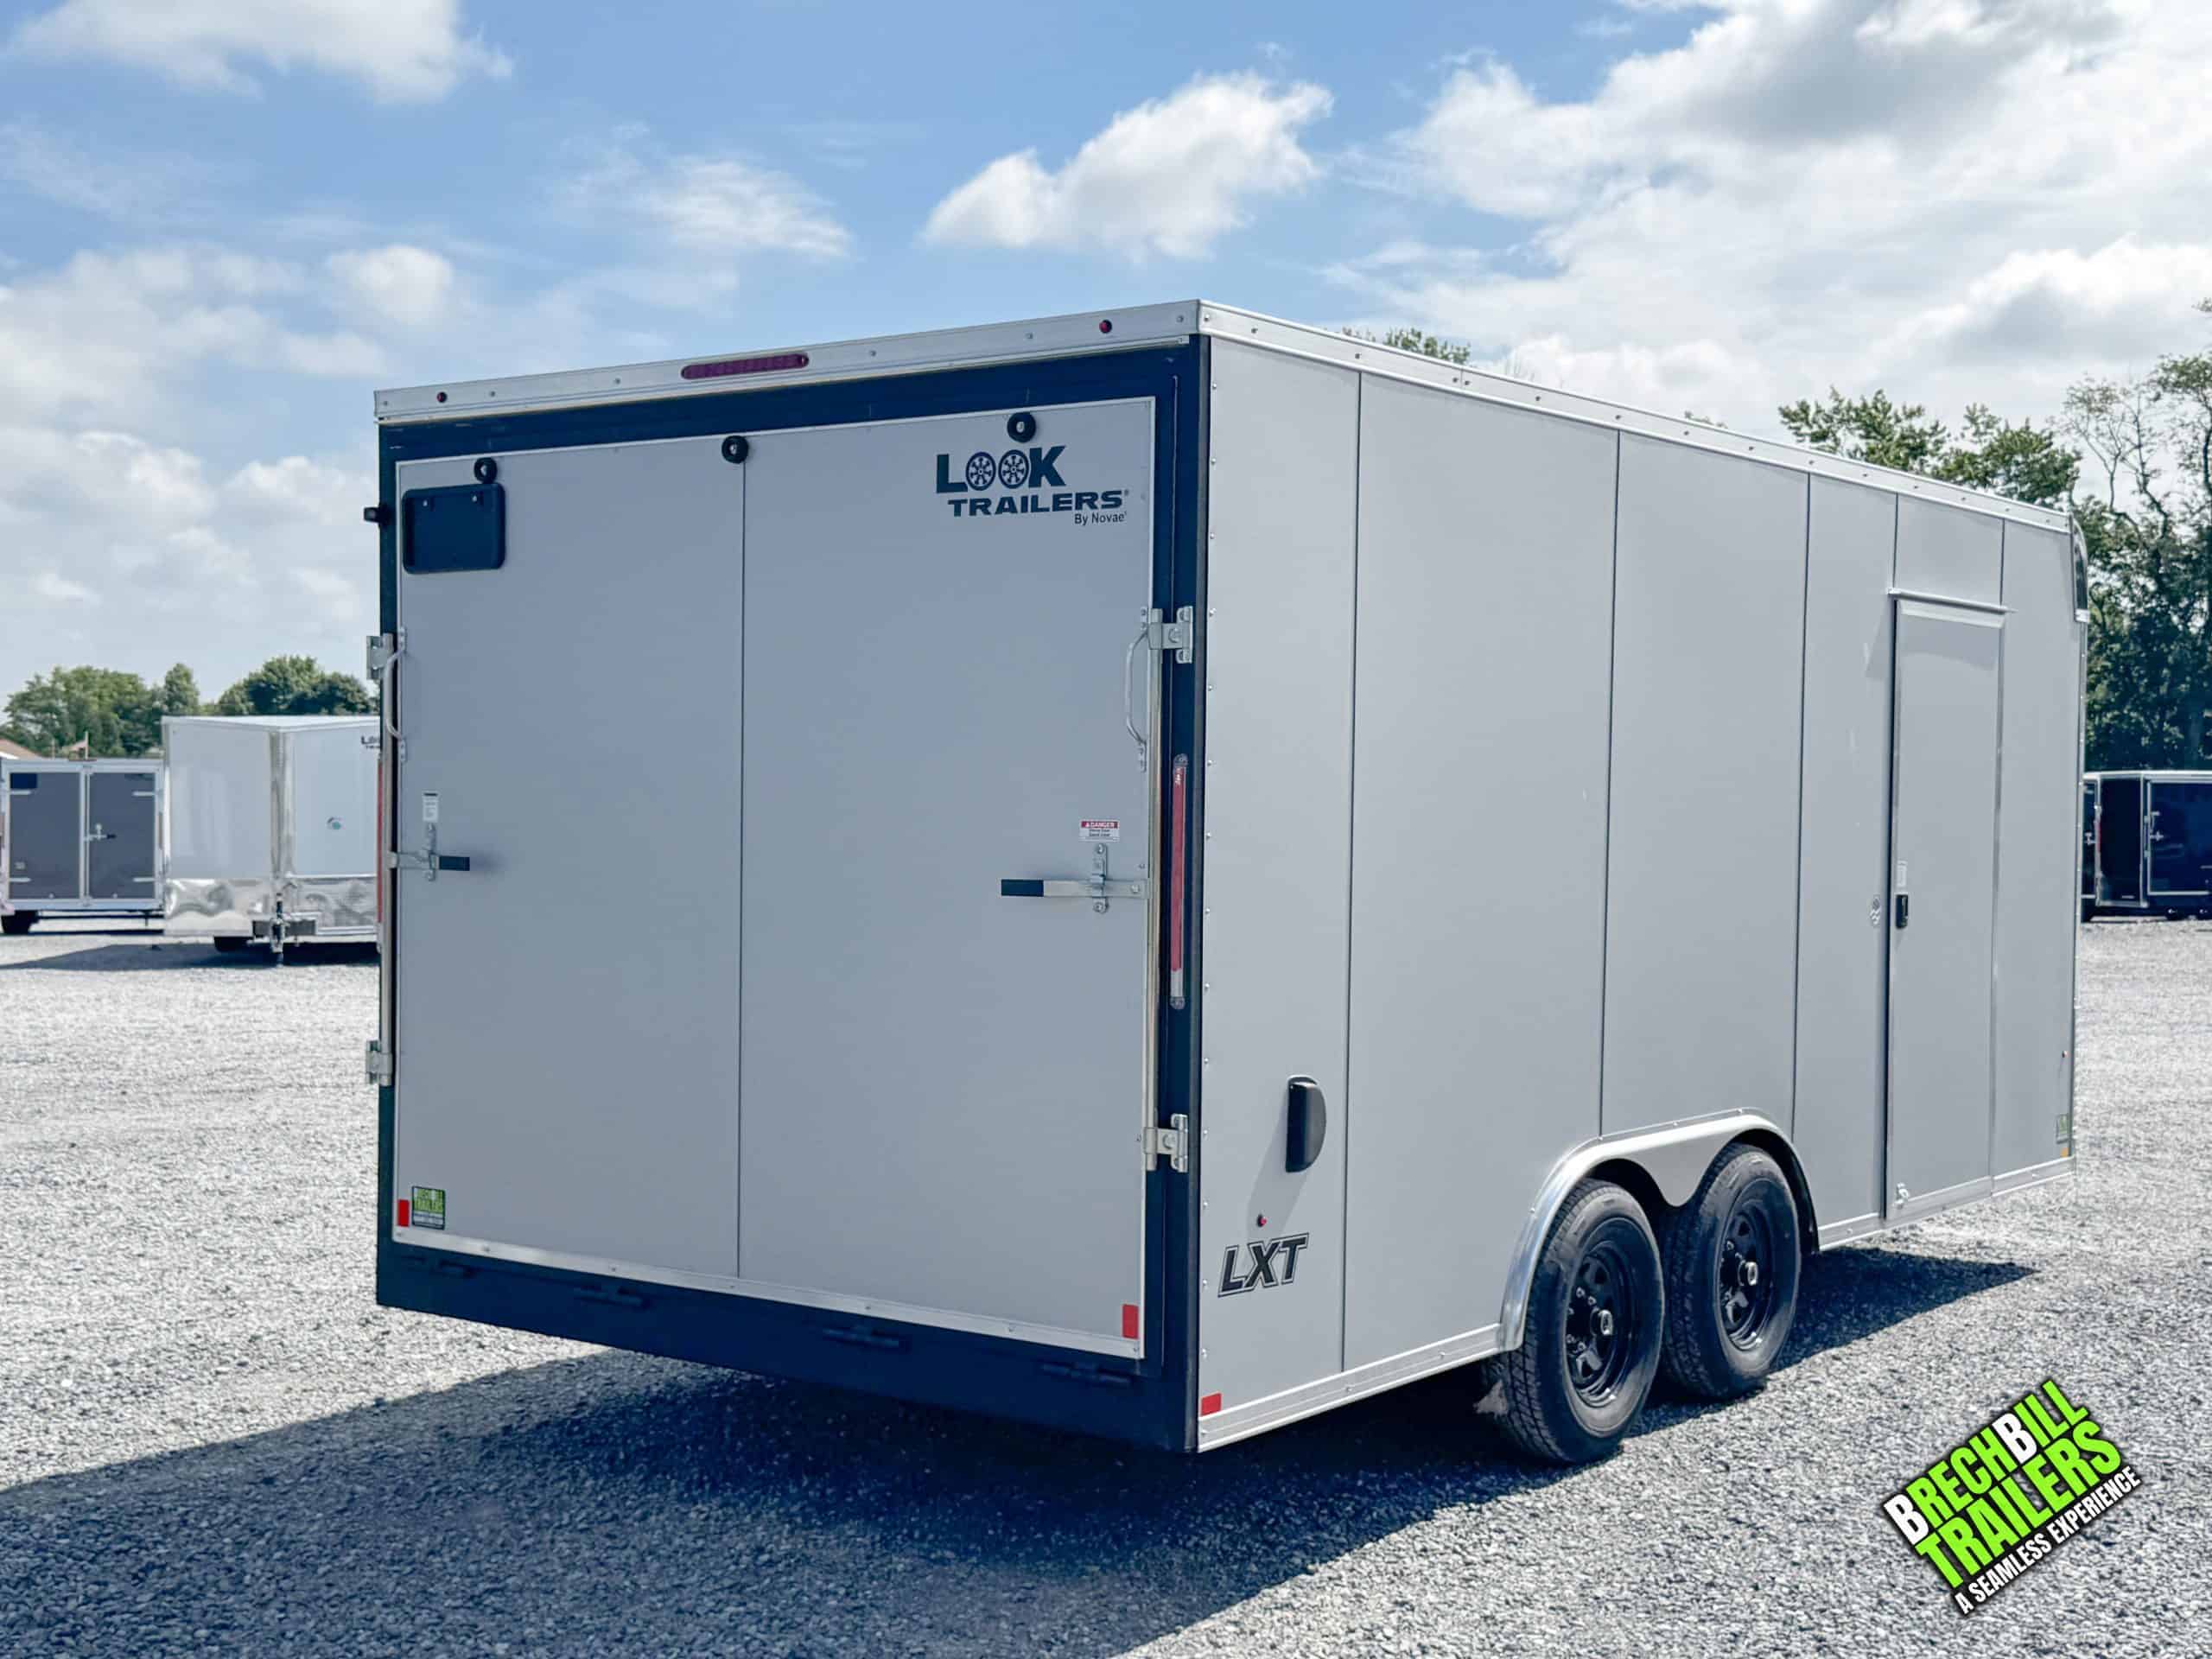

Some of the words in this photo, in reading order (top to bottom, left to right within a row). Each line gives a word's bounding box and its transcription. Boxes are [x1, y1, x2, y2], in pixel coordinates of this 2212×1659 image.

[936, 445, 1066, 493] LOOK
[948, 490, 1122, 517] TRAILERS
[1074, 513, 1089, 526] By
[1091, 512, 1125, 524] Novae
[1217, 1232, 1309, 1297] LXT
